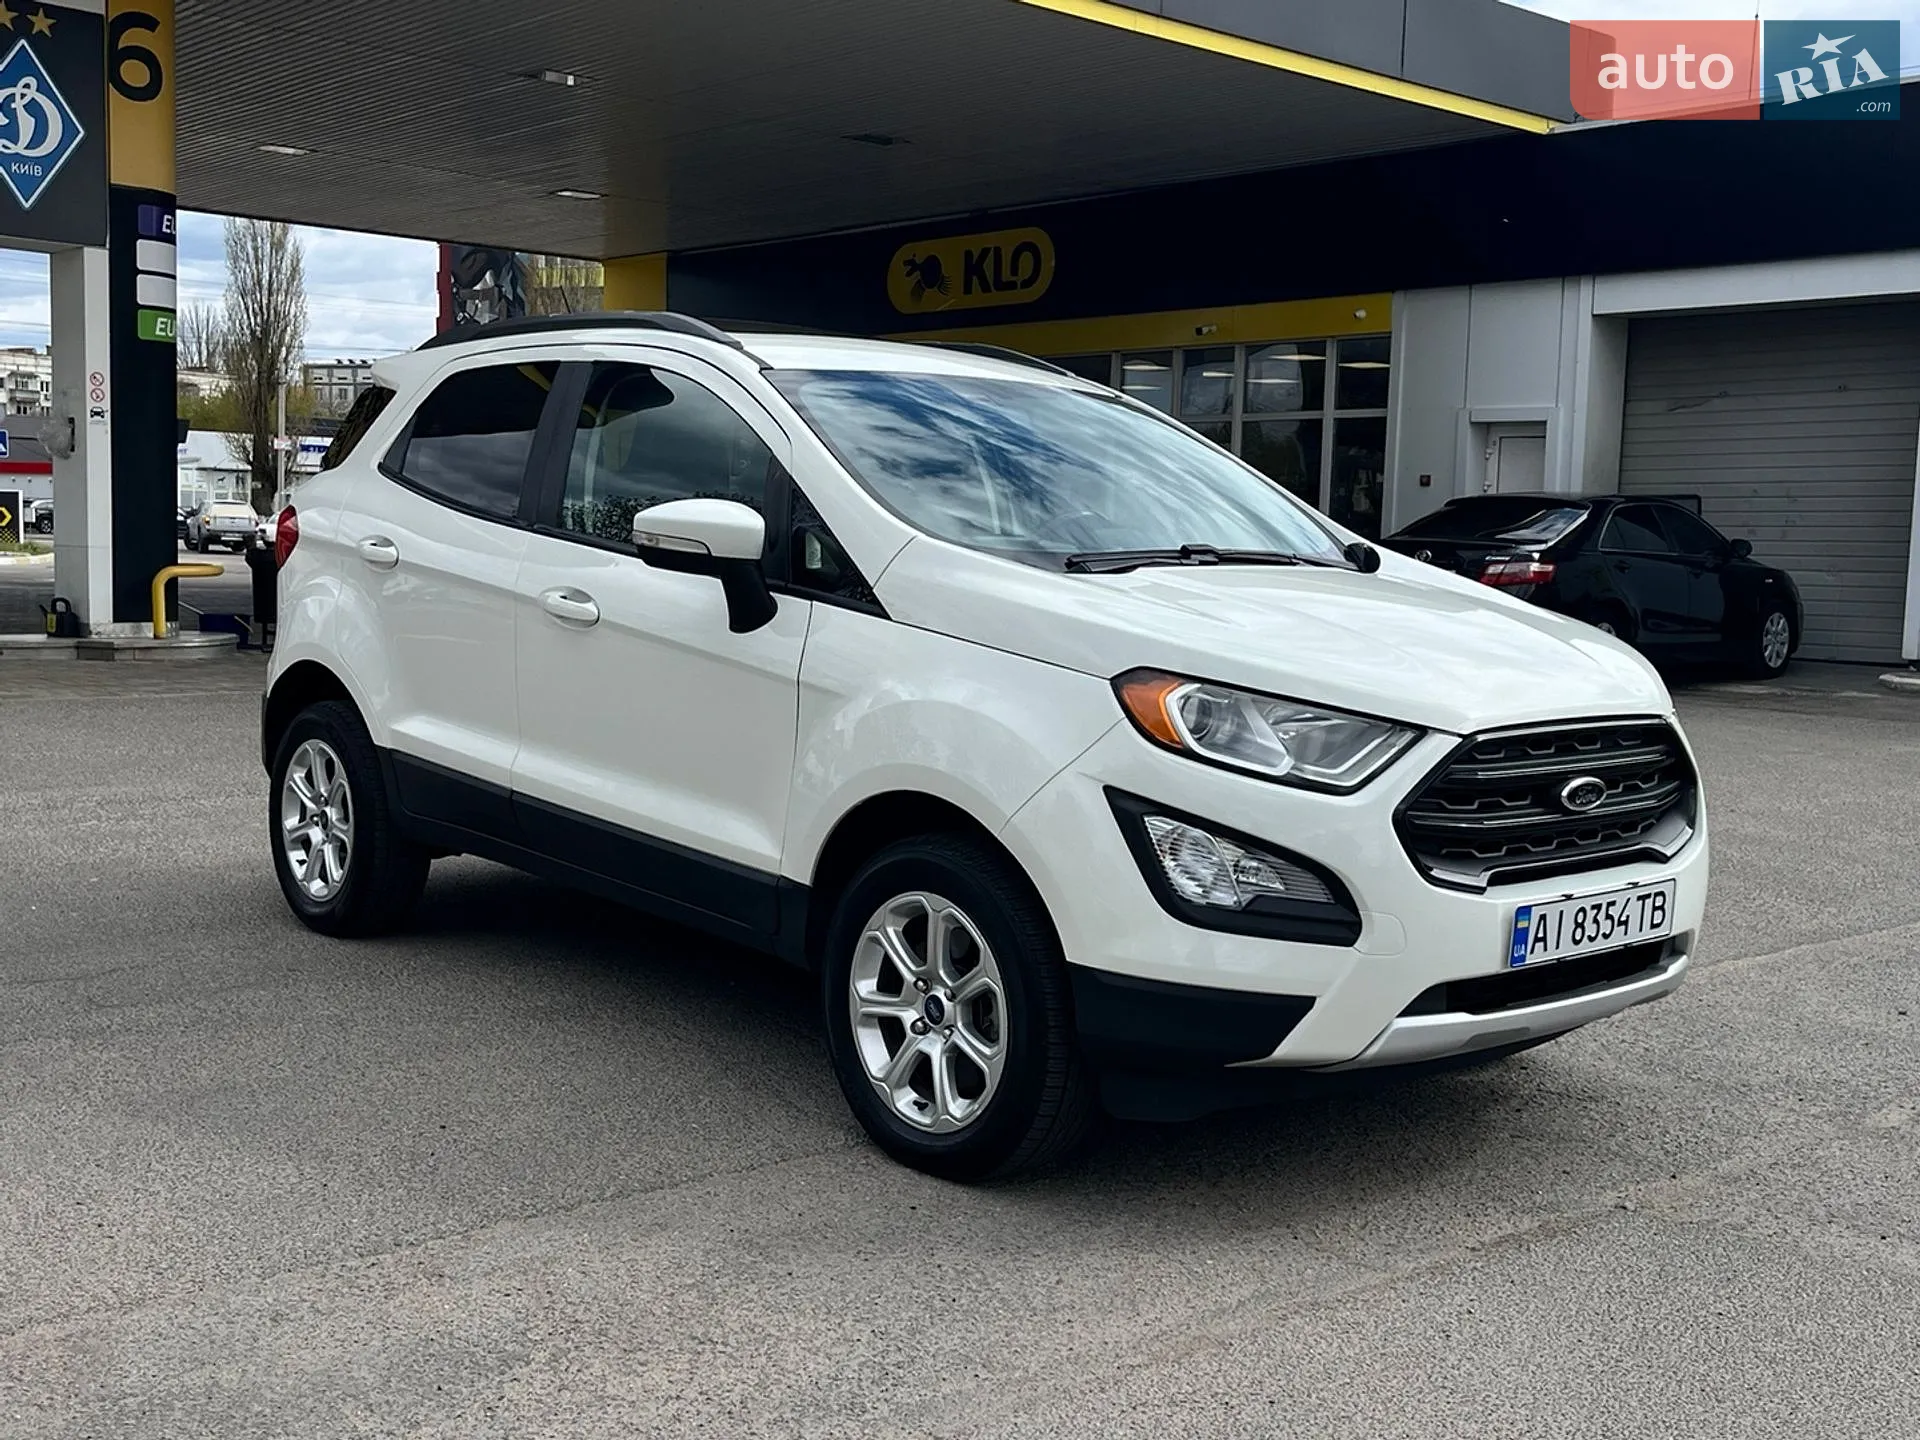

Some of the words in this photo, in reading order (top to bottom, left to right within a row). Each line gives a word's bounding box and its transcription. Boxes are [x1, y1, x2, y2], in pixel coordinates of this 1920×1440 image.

[109, 11, 163, 102] 6
[11, 162, 43, 177] КИЇВ
[963, 240, 1042, 295] KLO
[1571, 897, 1631, 946] 8354
[1636, 891, 1667, 933] TB
